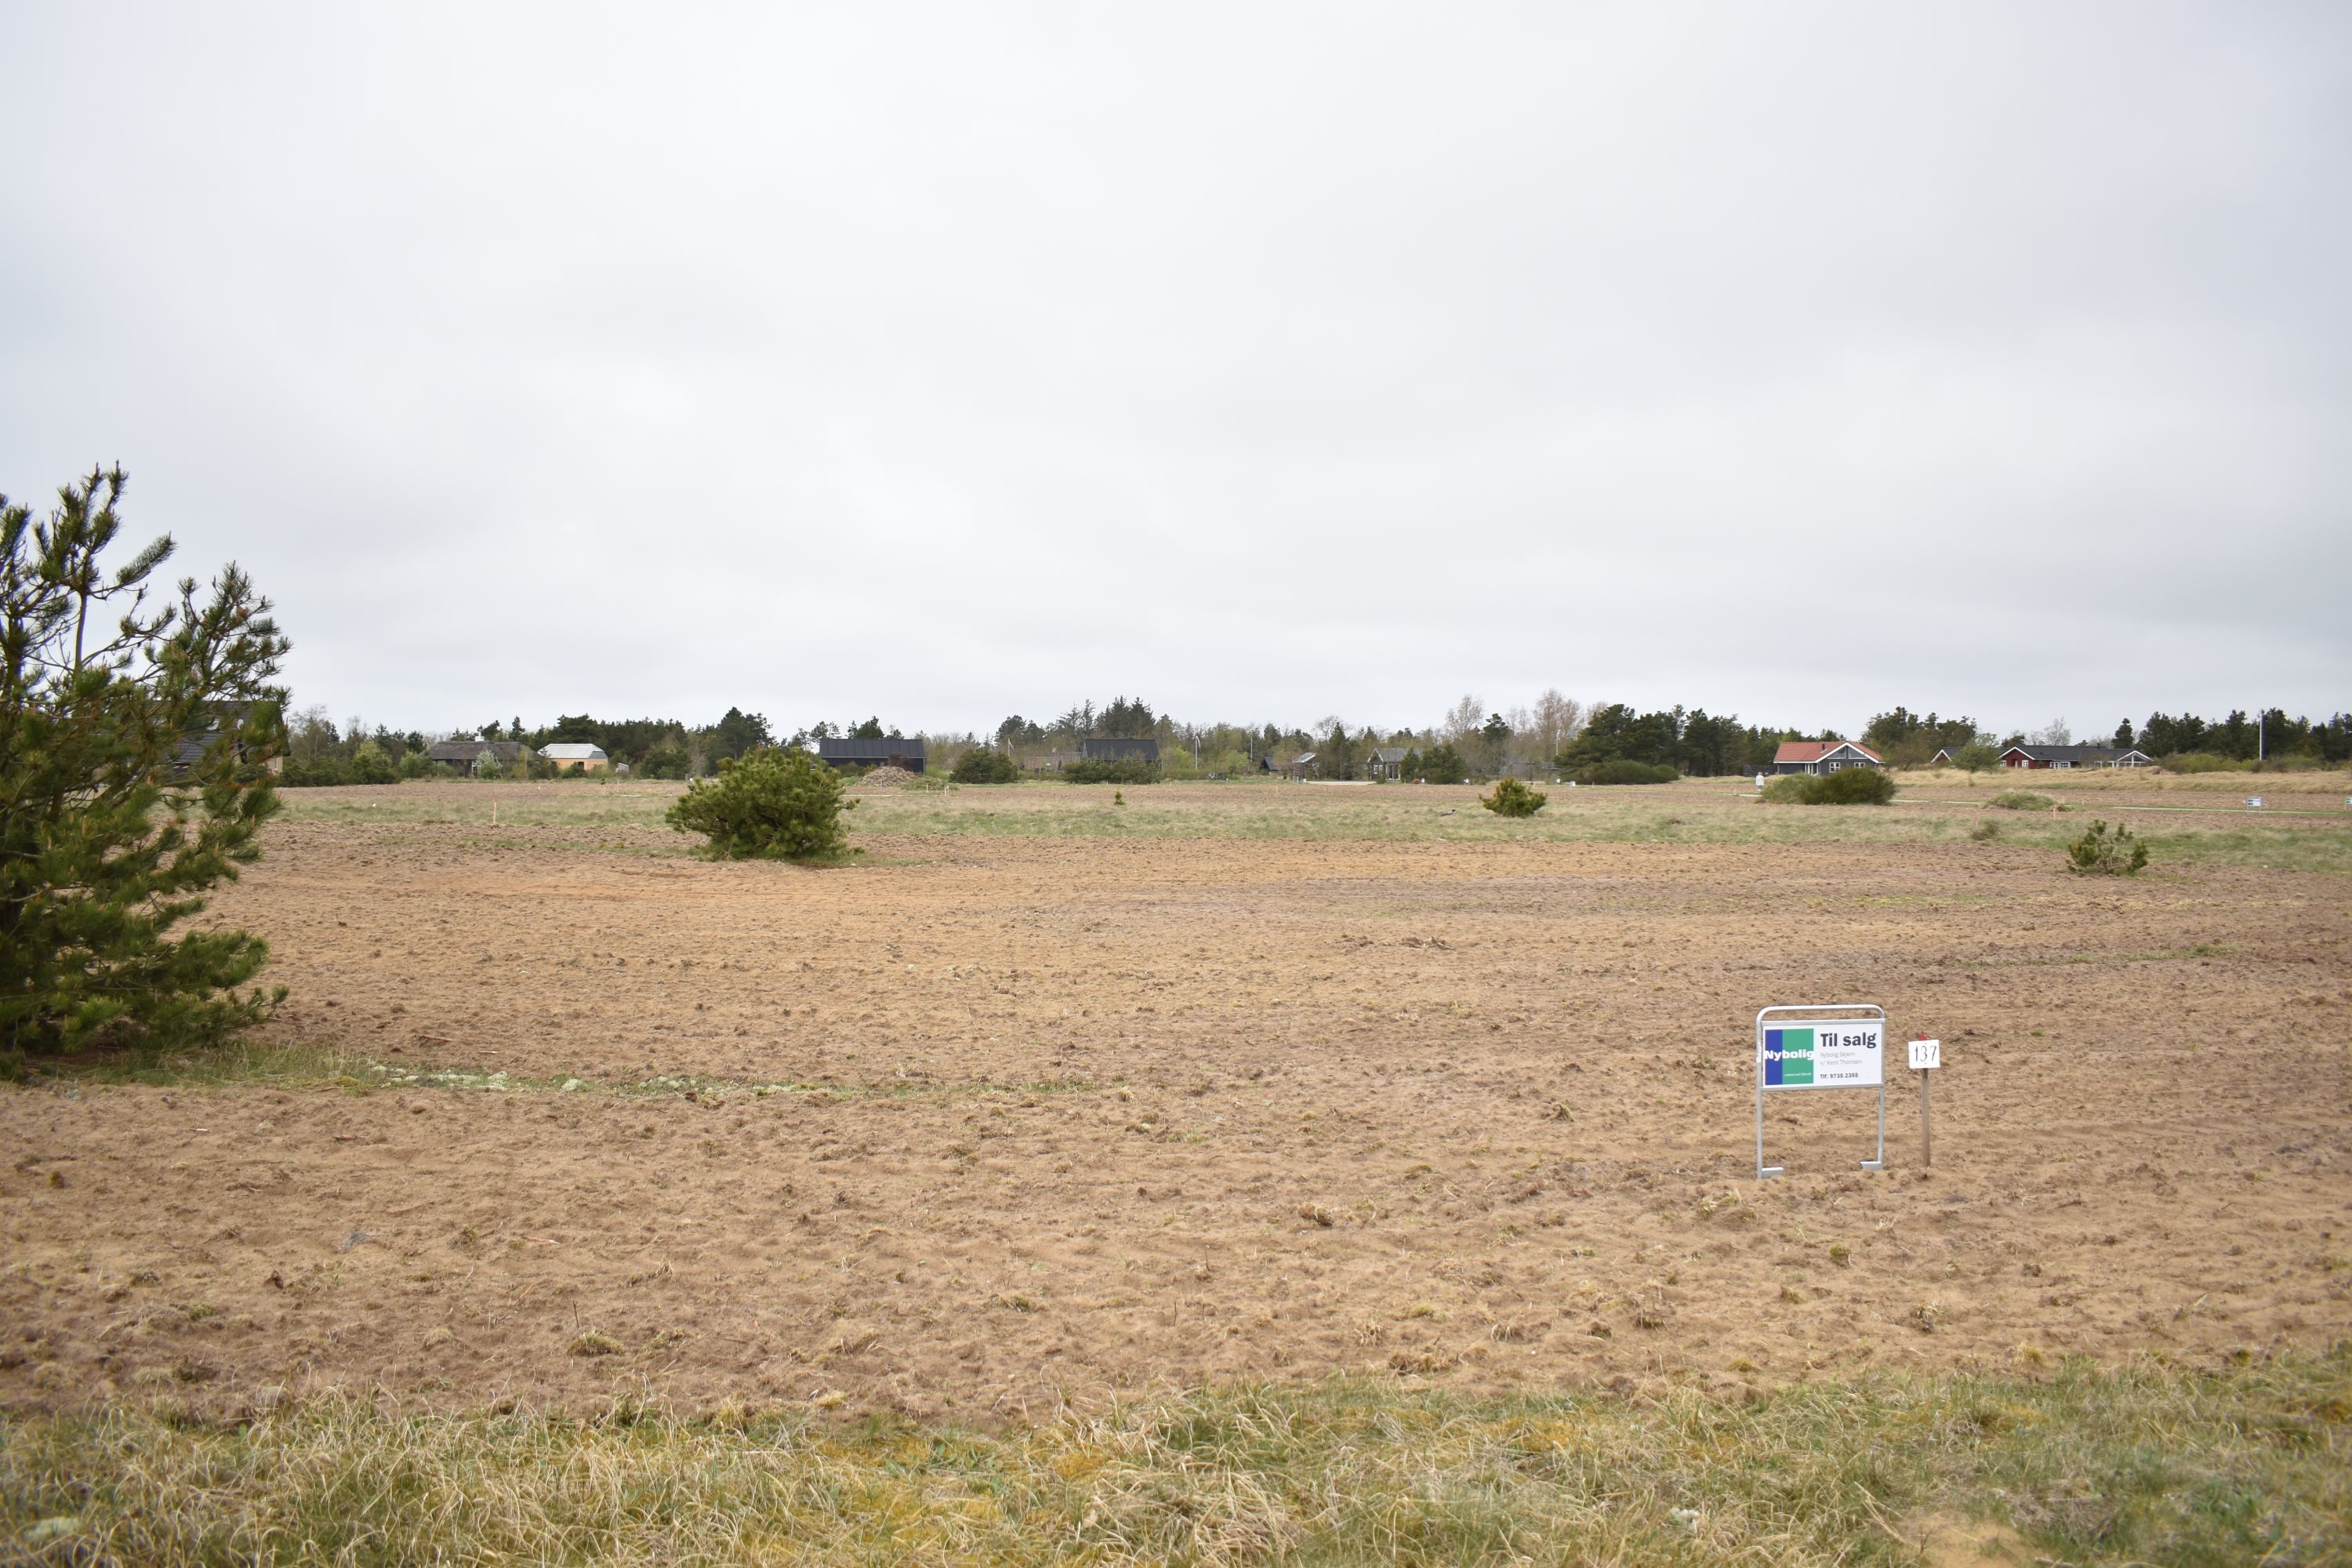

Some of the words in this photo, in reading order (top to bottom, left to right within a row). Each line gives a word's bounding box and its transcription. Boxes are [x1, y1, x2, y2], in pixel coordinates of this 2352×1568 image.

[1820, 1033, 1838, 1047] Til
[1842, 1032, 1877, 1049] salg
[1765, 1049, 1814, 1062] Nybolig
[1914, 1045, 1937, 1062] 137
